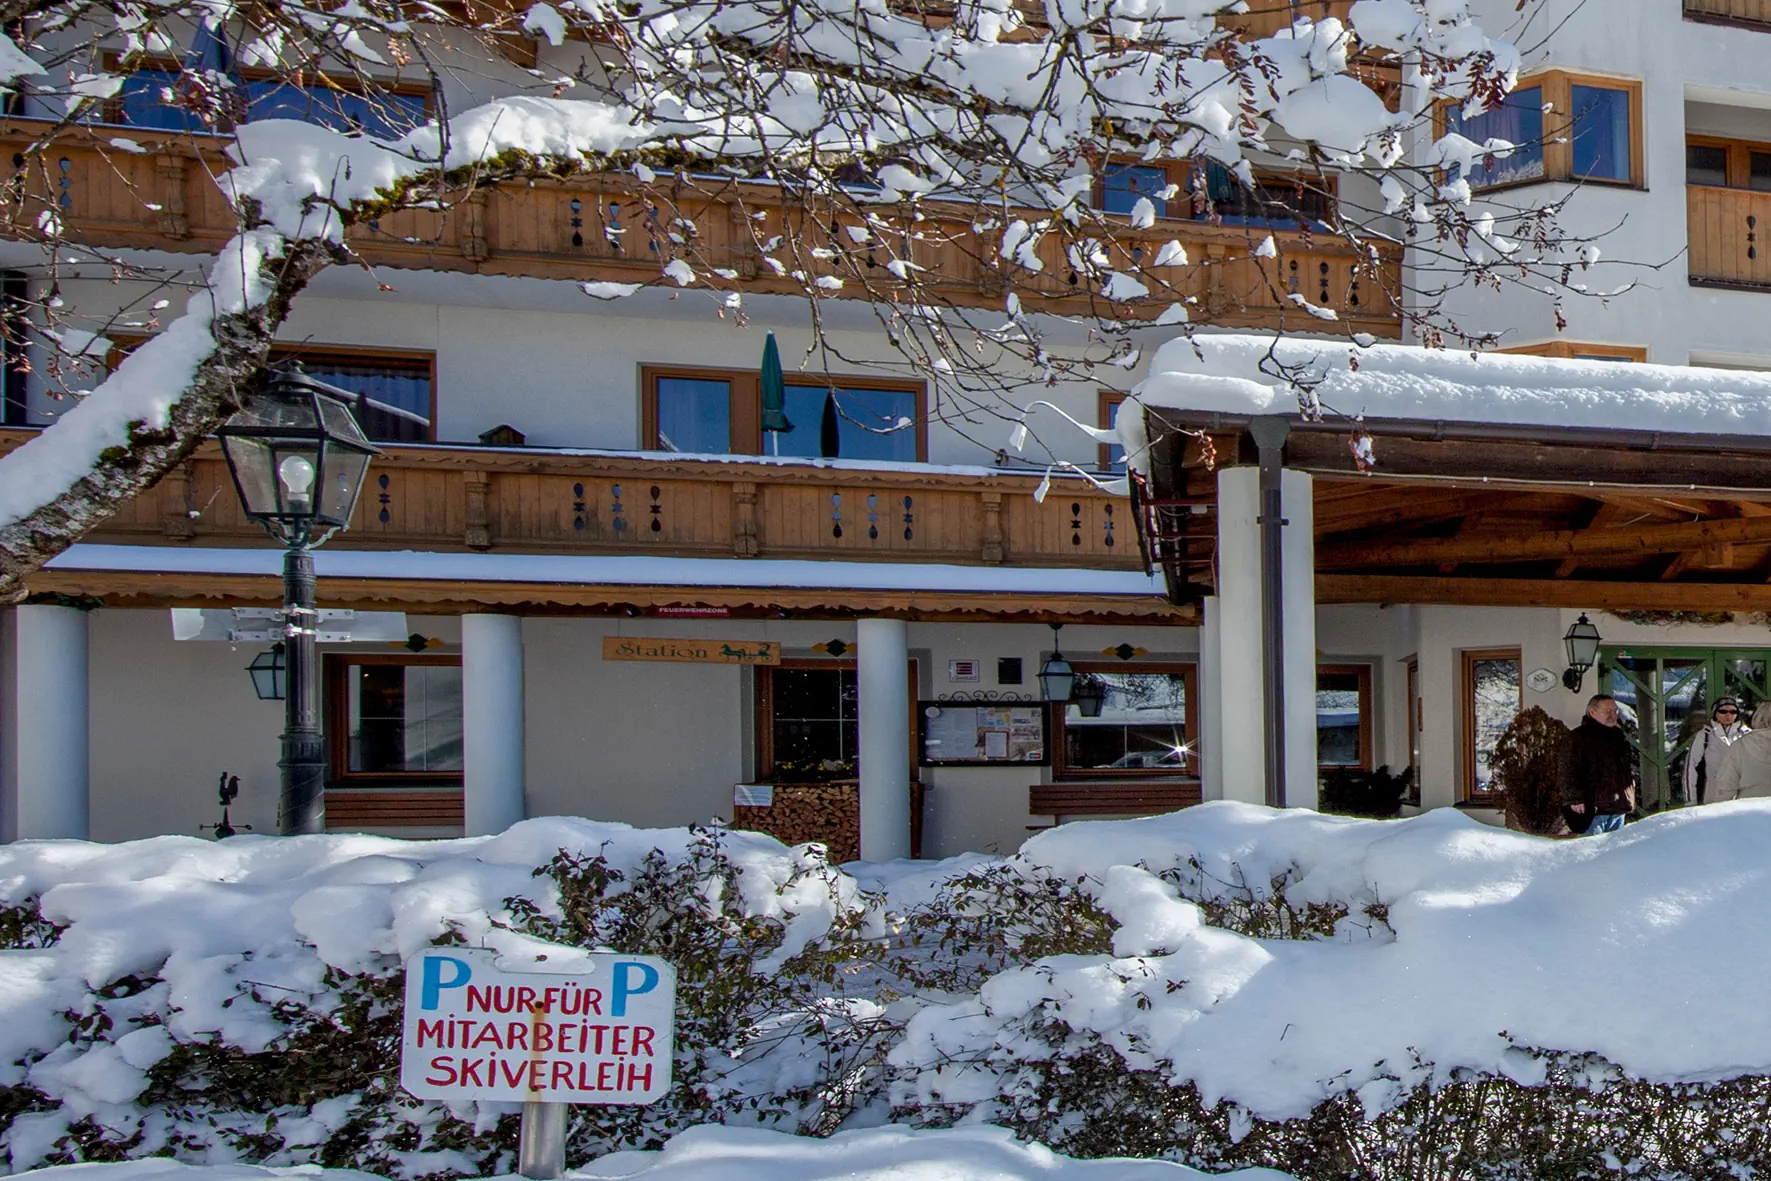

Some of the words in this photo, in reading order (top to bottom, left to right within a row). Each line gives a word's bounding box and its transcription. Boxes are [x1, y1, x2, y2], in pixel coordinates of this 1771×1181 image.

[616, 642, 707, 658] Station
[421, 956, 472, 1010] P
[467, 985, 537, 1014] NUR
[544, 981, 602, 1015] FÜR
[611, 961, 659, 1017] P
[417, 1013, 655, 1057] MITARBEITER
[425, 1051, 653, 1092] SKIVERLEIH
